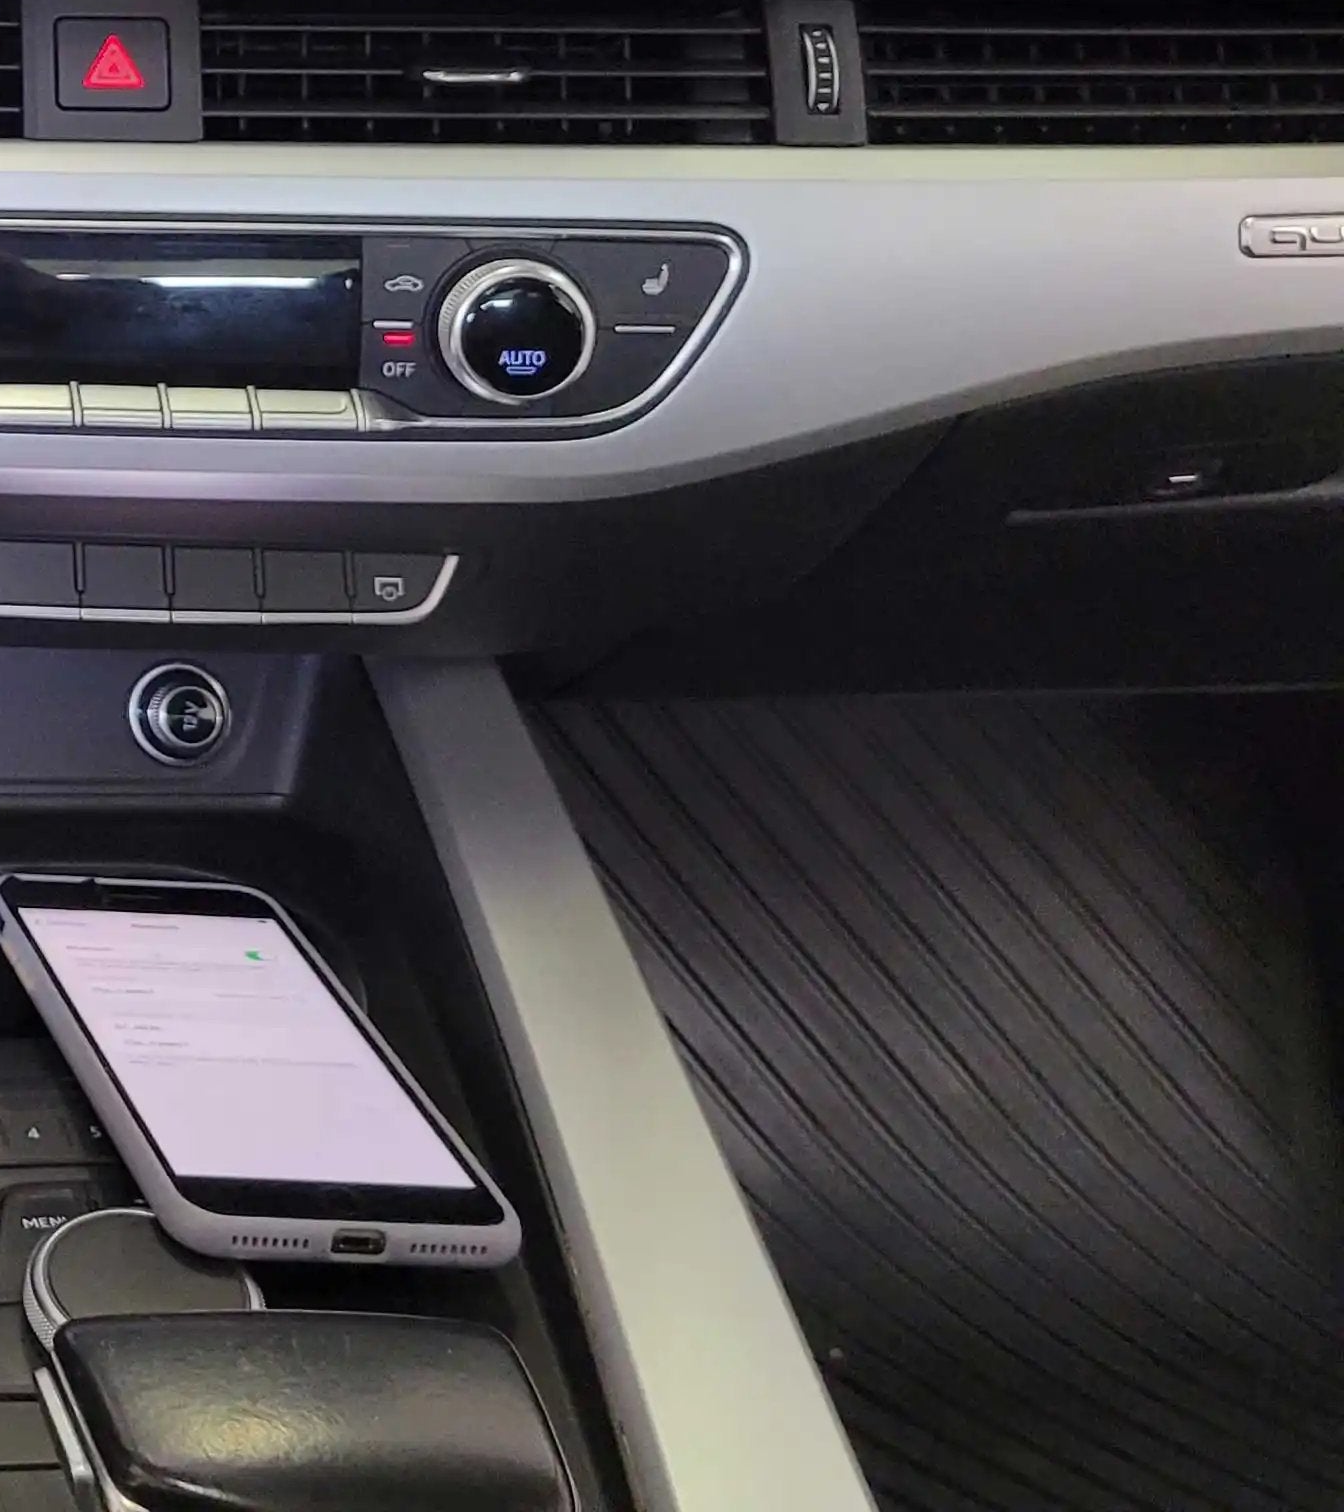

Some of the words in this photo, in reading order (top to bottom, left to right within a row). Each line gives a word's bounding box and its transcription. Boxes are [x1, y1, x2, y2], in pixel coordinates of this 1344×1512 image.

[498, 350, 546, 366] AUTO
[382, 361, 417, 379] OFF
[27, 1126, 41, 1139] 4
[22, 1216, 69, 1229] MEN
